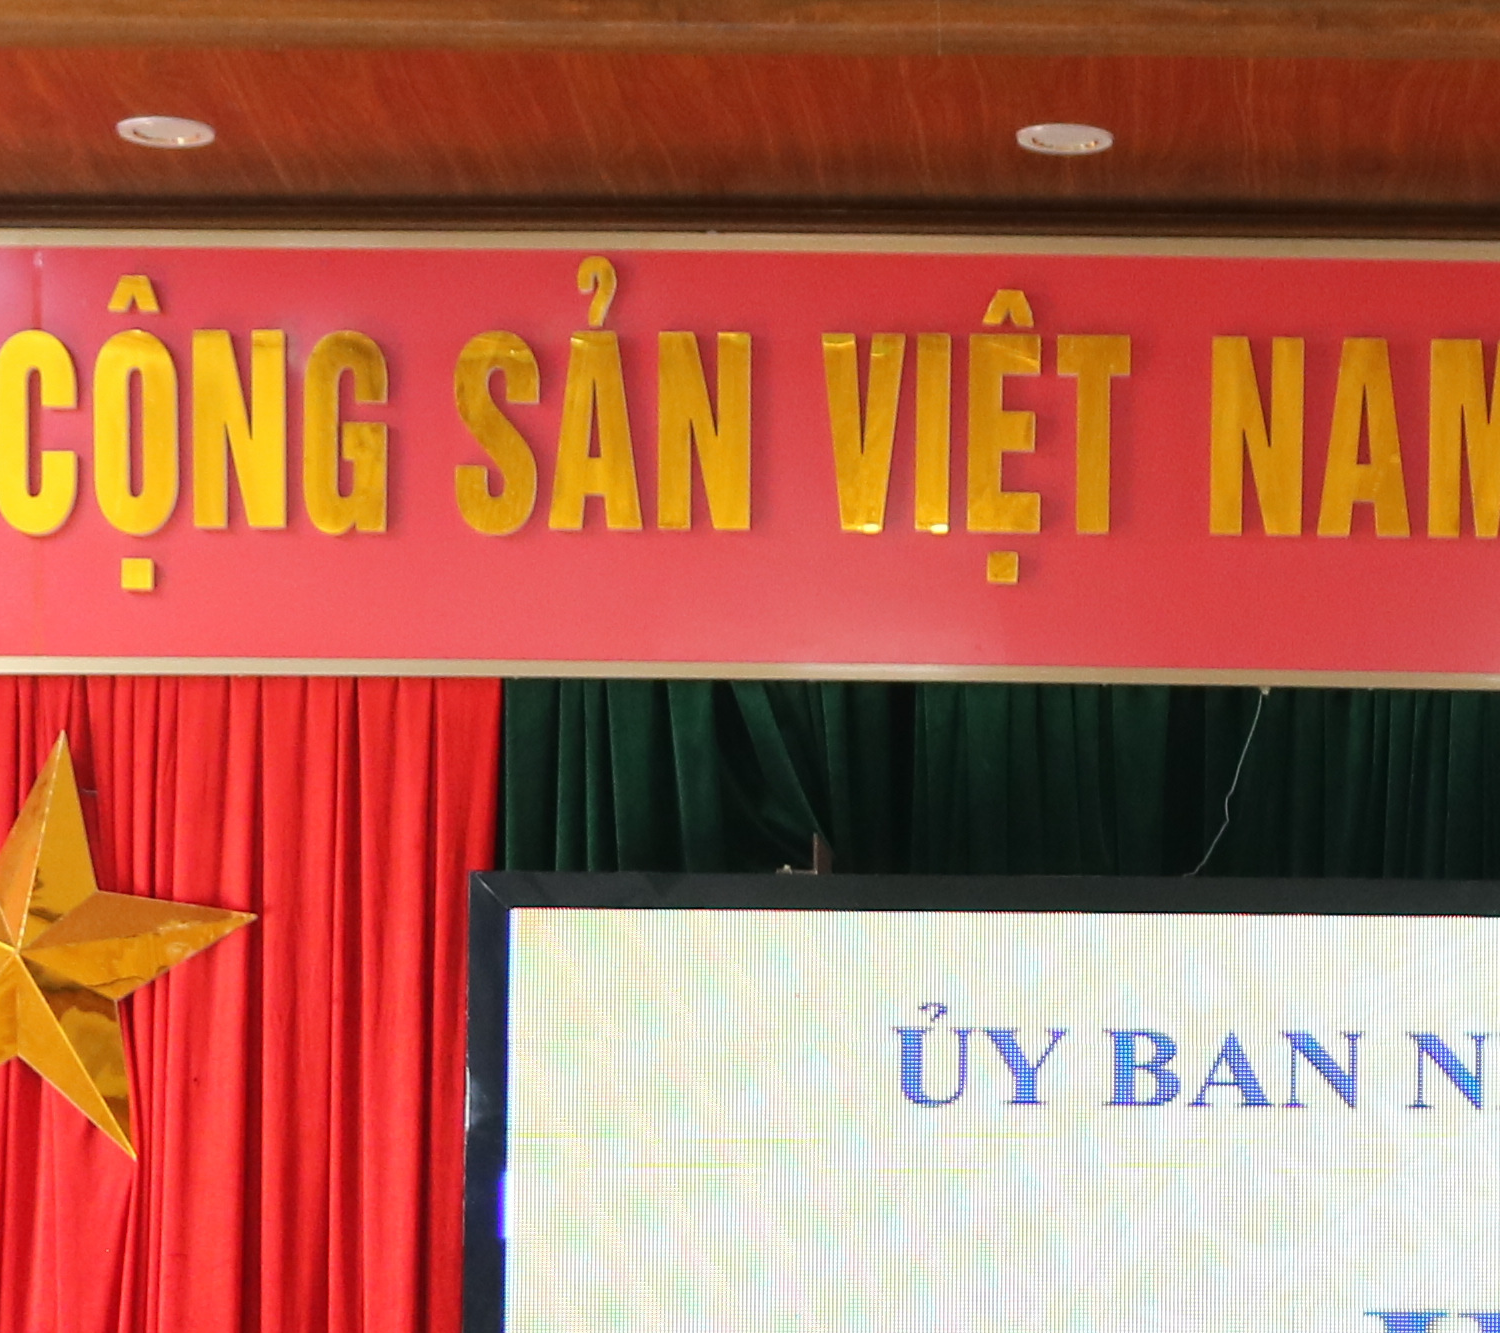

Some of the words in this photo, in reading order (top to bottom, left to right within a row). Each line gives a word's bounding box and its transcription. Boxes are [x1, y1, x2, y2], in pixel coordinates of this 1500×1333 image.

[454, 256, 752, 535] SẢN
[822, 289, 1132, 585] VIỆT
[896, 1002, 1067, 1108] ỦY
[1105, 1028, 1362, 1107] BAN
